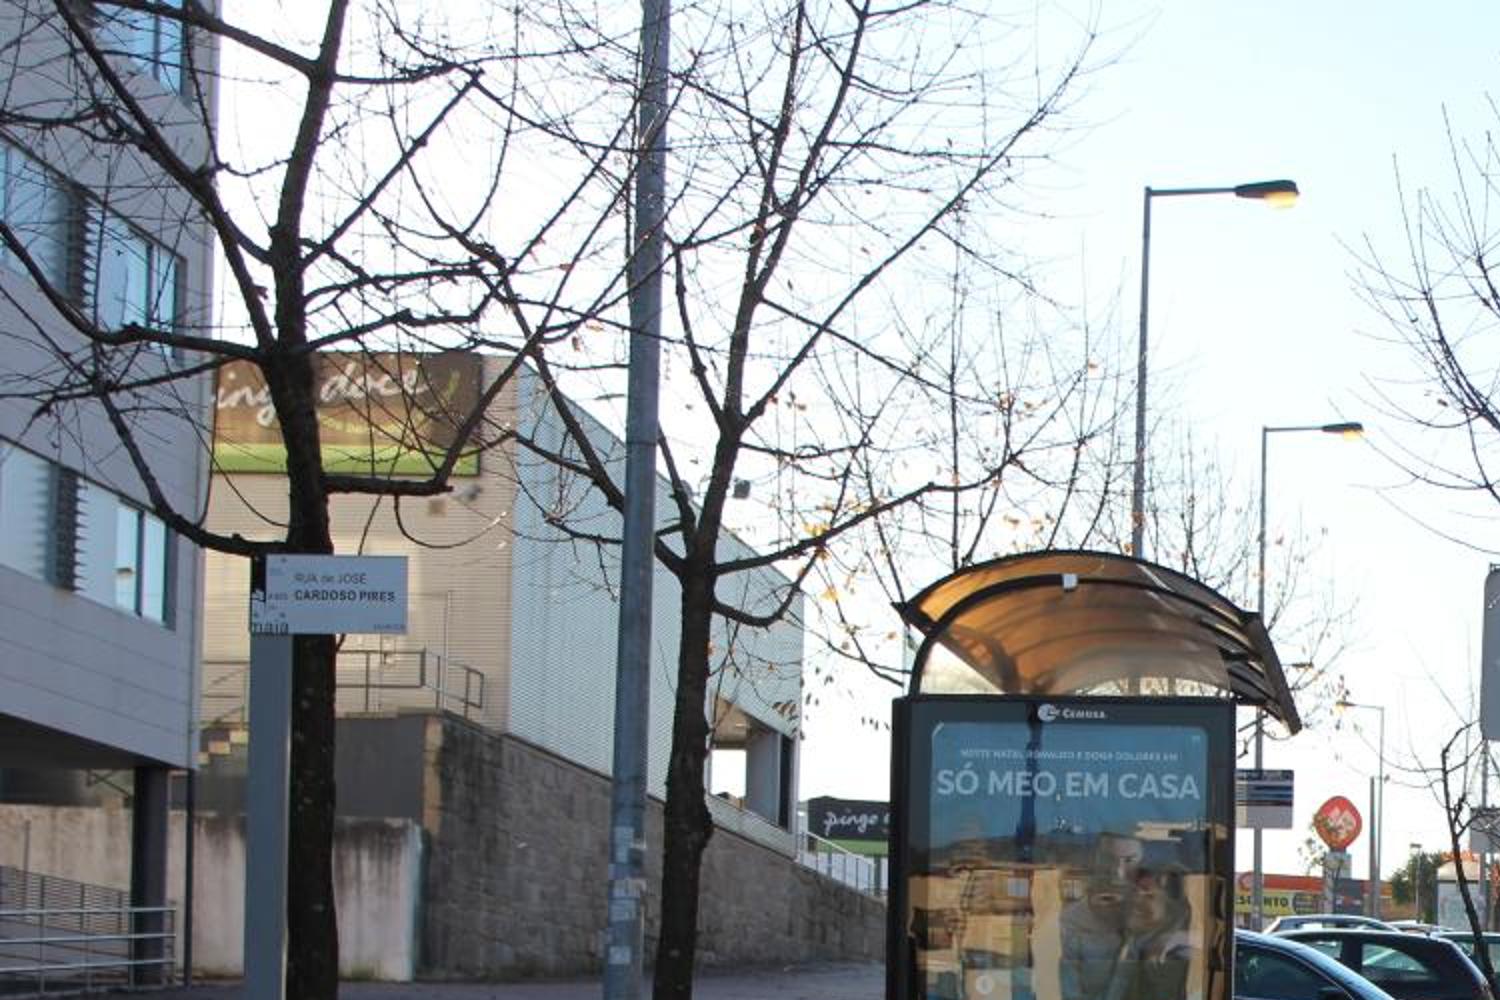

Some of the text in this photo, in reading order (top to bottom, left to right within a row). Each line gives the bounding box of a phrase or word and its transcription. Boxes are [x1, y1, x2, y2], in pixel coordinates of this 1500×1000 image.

[294, 589, 356, 602] CARDOSO
[359, 591, 395, 603] PIRES
[937, 761, 979, 796] SÓ
[1065, 771, 1109, 798] EM
[1118, 773, 1200, 800] CASA
[823, 808, 879, 836] pingo
